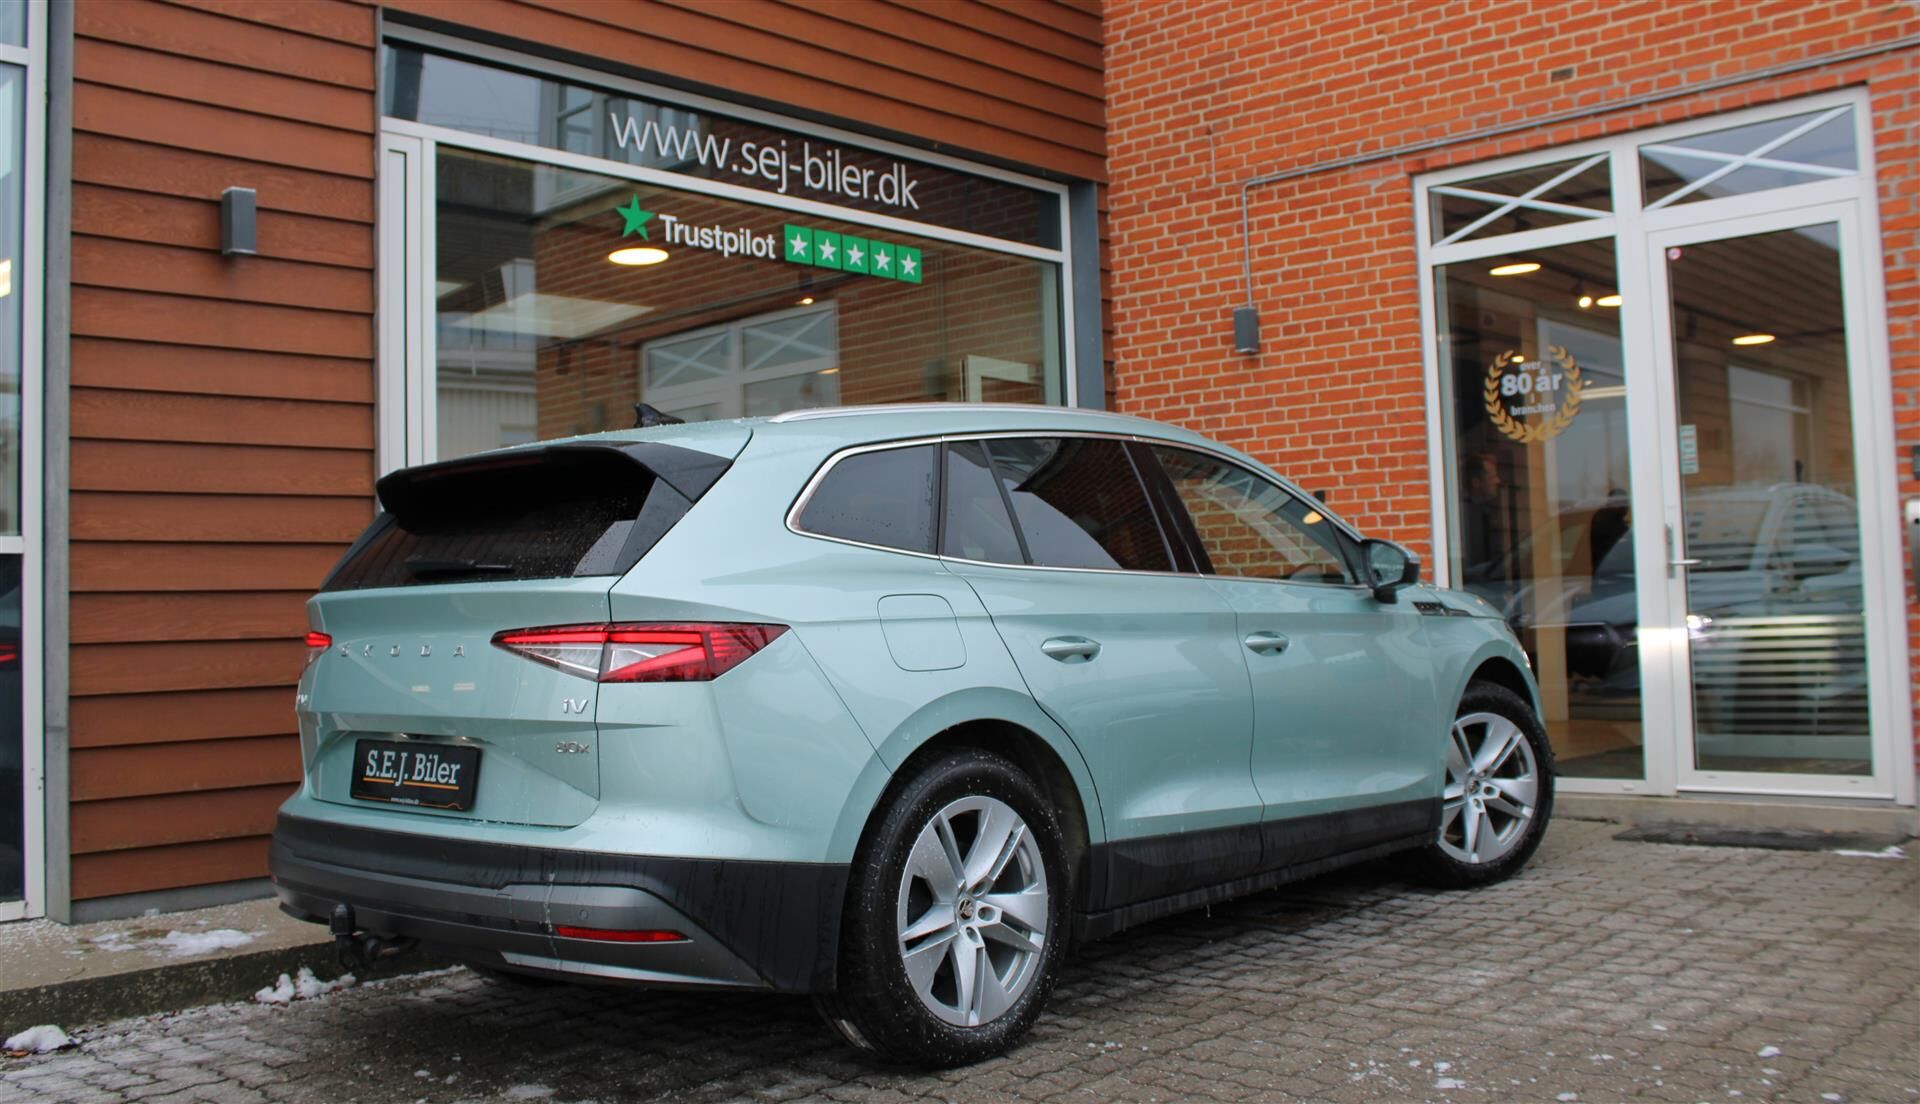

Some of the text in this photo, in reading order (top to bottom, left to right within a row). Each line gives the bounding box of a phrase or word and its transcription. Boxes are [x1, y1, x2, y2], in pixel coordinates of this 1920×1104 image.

[611, 112, 919, 210] www.sej-biler.dk
[659, 214, 777, 259] Trustpilot
[1501, 368, 1563, 396] 80 år
[366, 750, 461, 787] S.E.J. Biler
